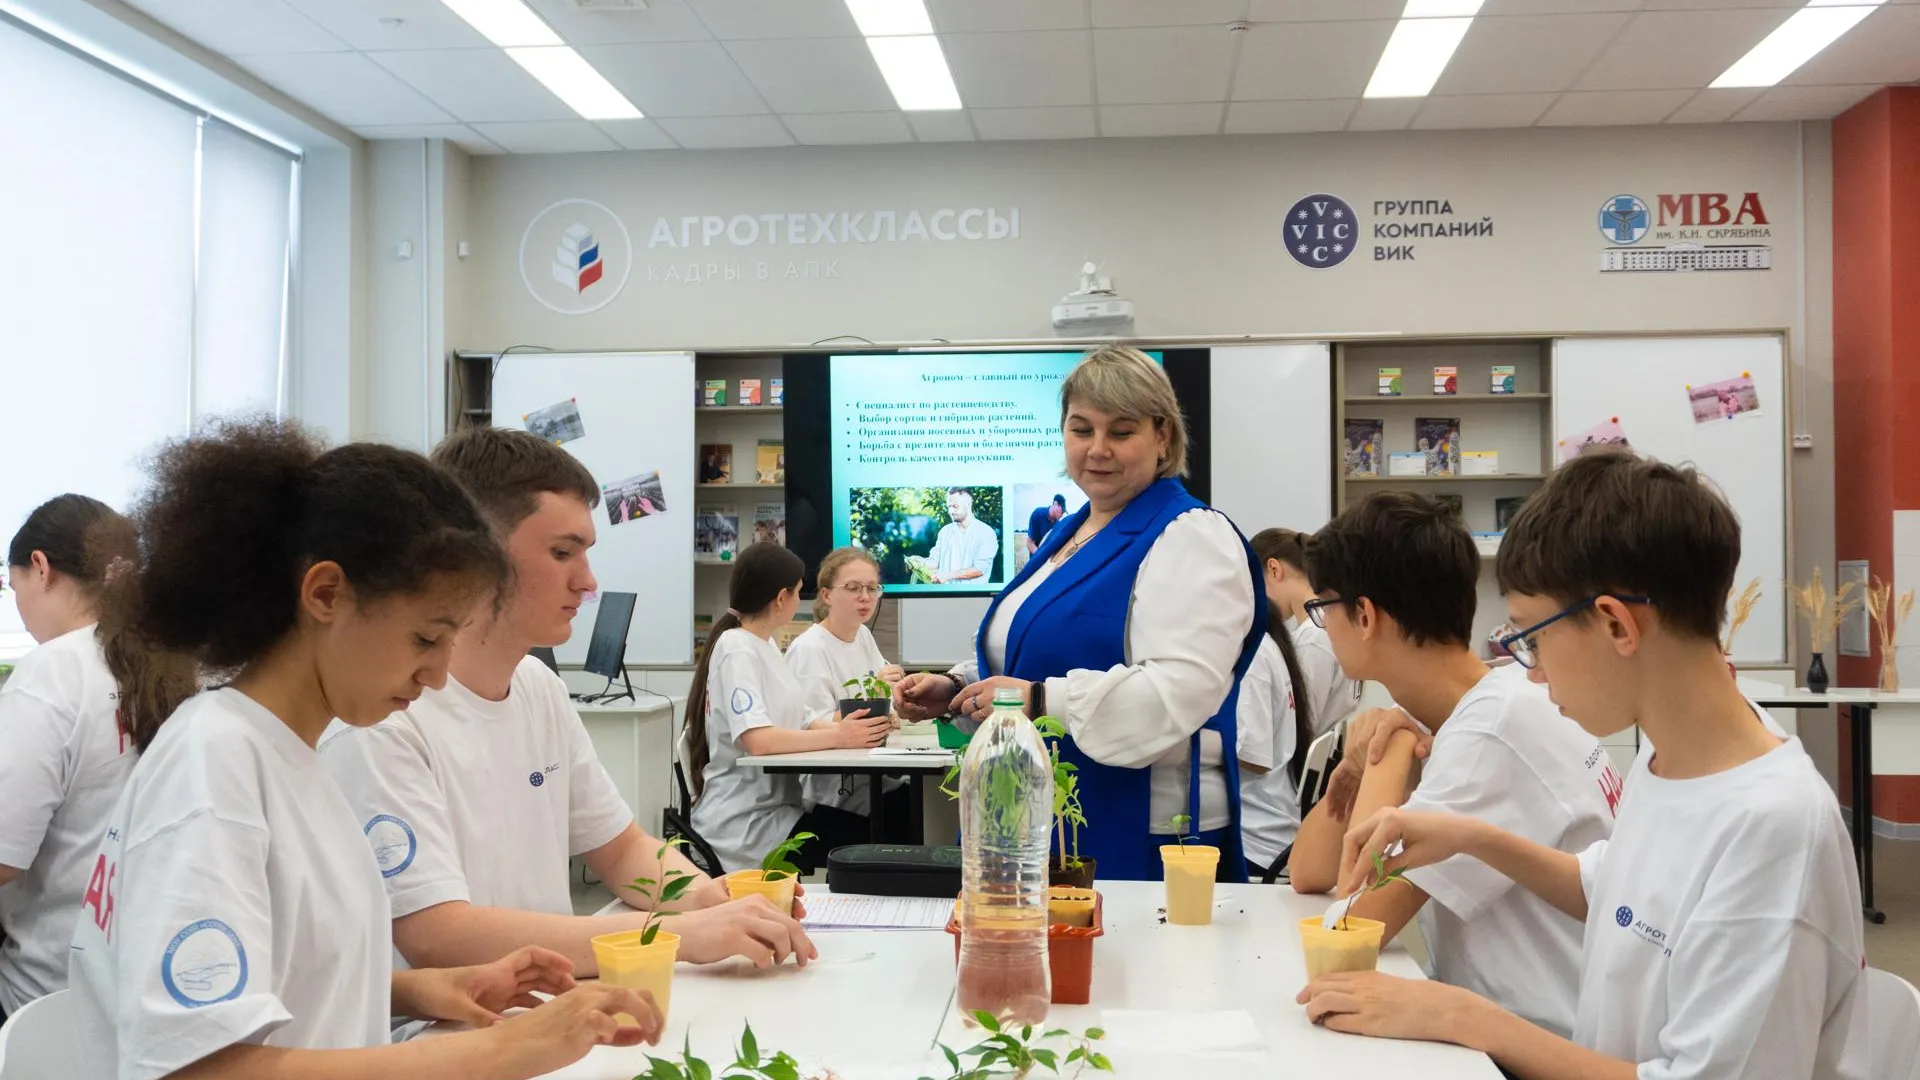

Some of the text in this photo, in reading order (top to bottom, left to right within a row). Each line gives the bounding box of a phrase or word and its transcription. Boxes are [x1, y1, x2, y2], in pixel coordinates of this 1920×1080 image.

[1374, 200, 1454, 216] ГРУППА
[1656, 192, 1771, 227] МВА
[648, 207, 1021, 248] АГРОТЕХКЛАССЫ
[1374, 217, 1494, 238] КОМПАНИЙ
[1707, 228, 1771, 238] СКРЯБИНА
[1374, 245, 1415, 261] ВИК
[647, 259, 841, 284] КАДРЫ В АПК
[920, 373, 963, 383] Агроном
[856, 401, 916, 409] Специалист
[919, 401, 931, 409] по
[859, 414, 892, 424] Выбор
[894, 414, 927, 424] сортов
[939, 413, 985, 423] гибридов
[859, 427, 925, 438] Организация
[988, 426, 1042, 436] уборочных
[859, 441, 895, 451] Борьба
[905, 441, 970, 450] вредителями
[982, 439, 1034, 448] болезнями
[859, 454, 907, 464] Контроль
[910, 455, 954, 463] качества
